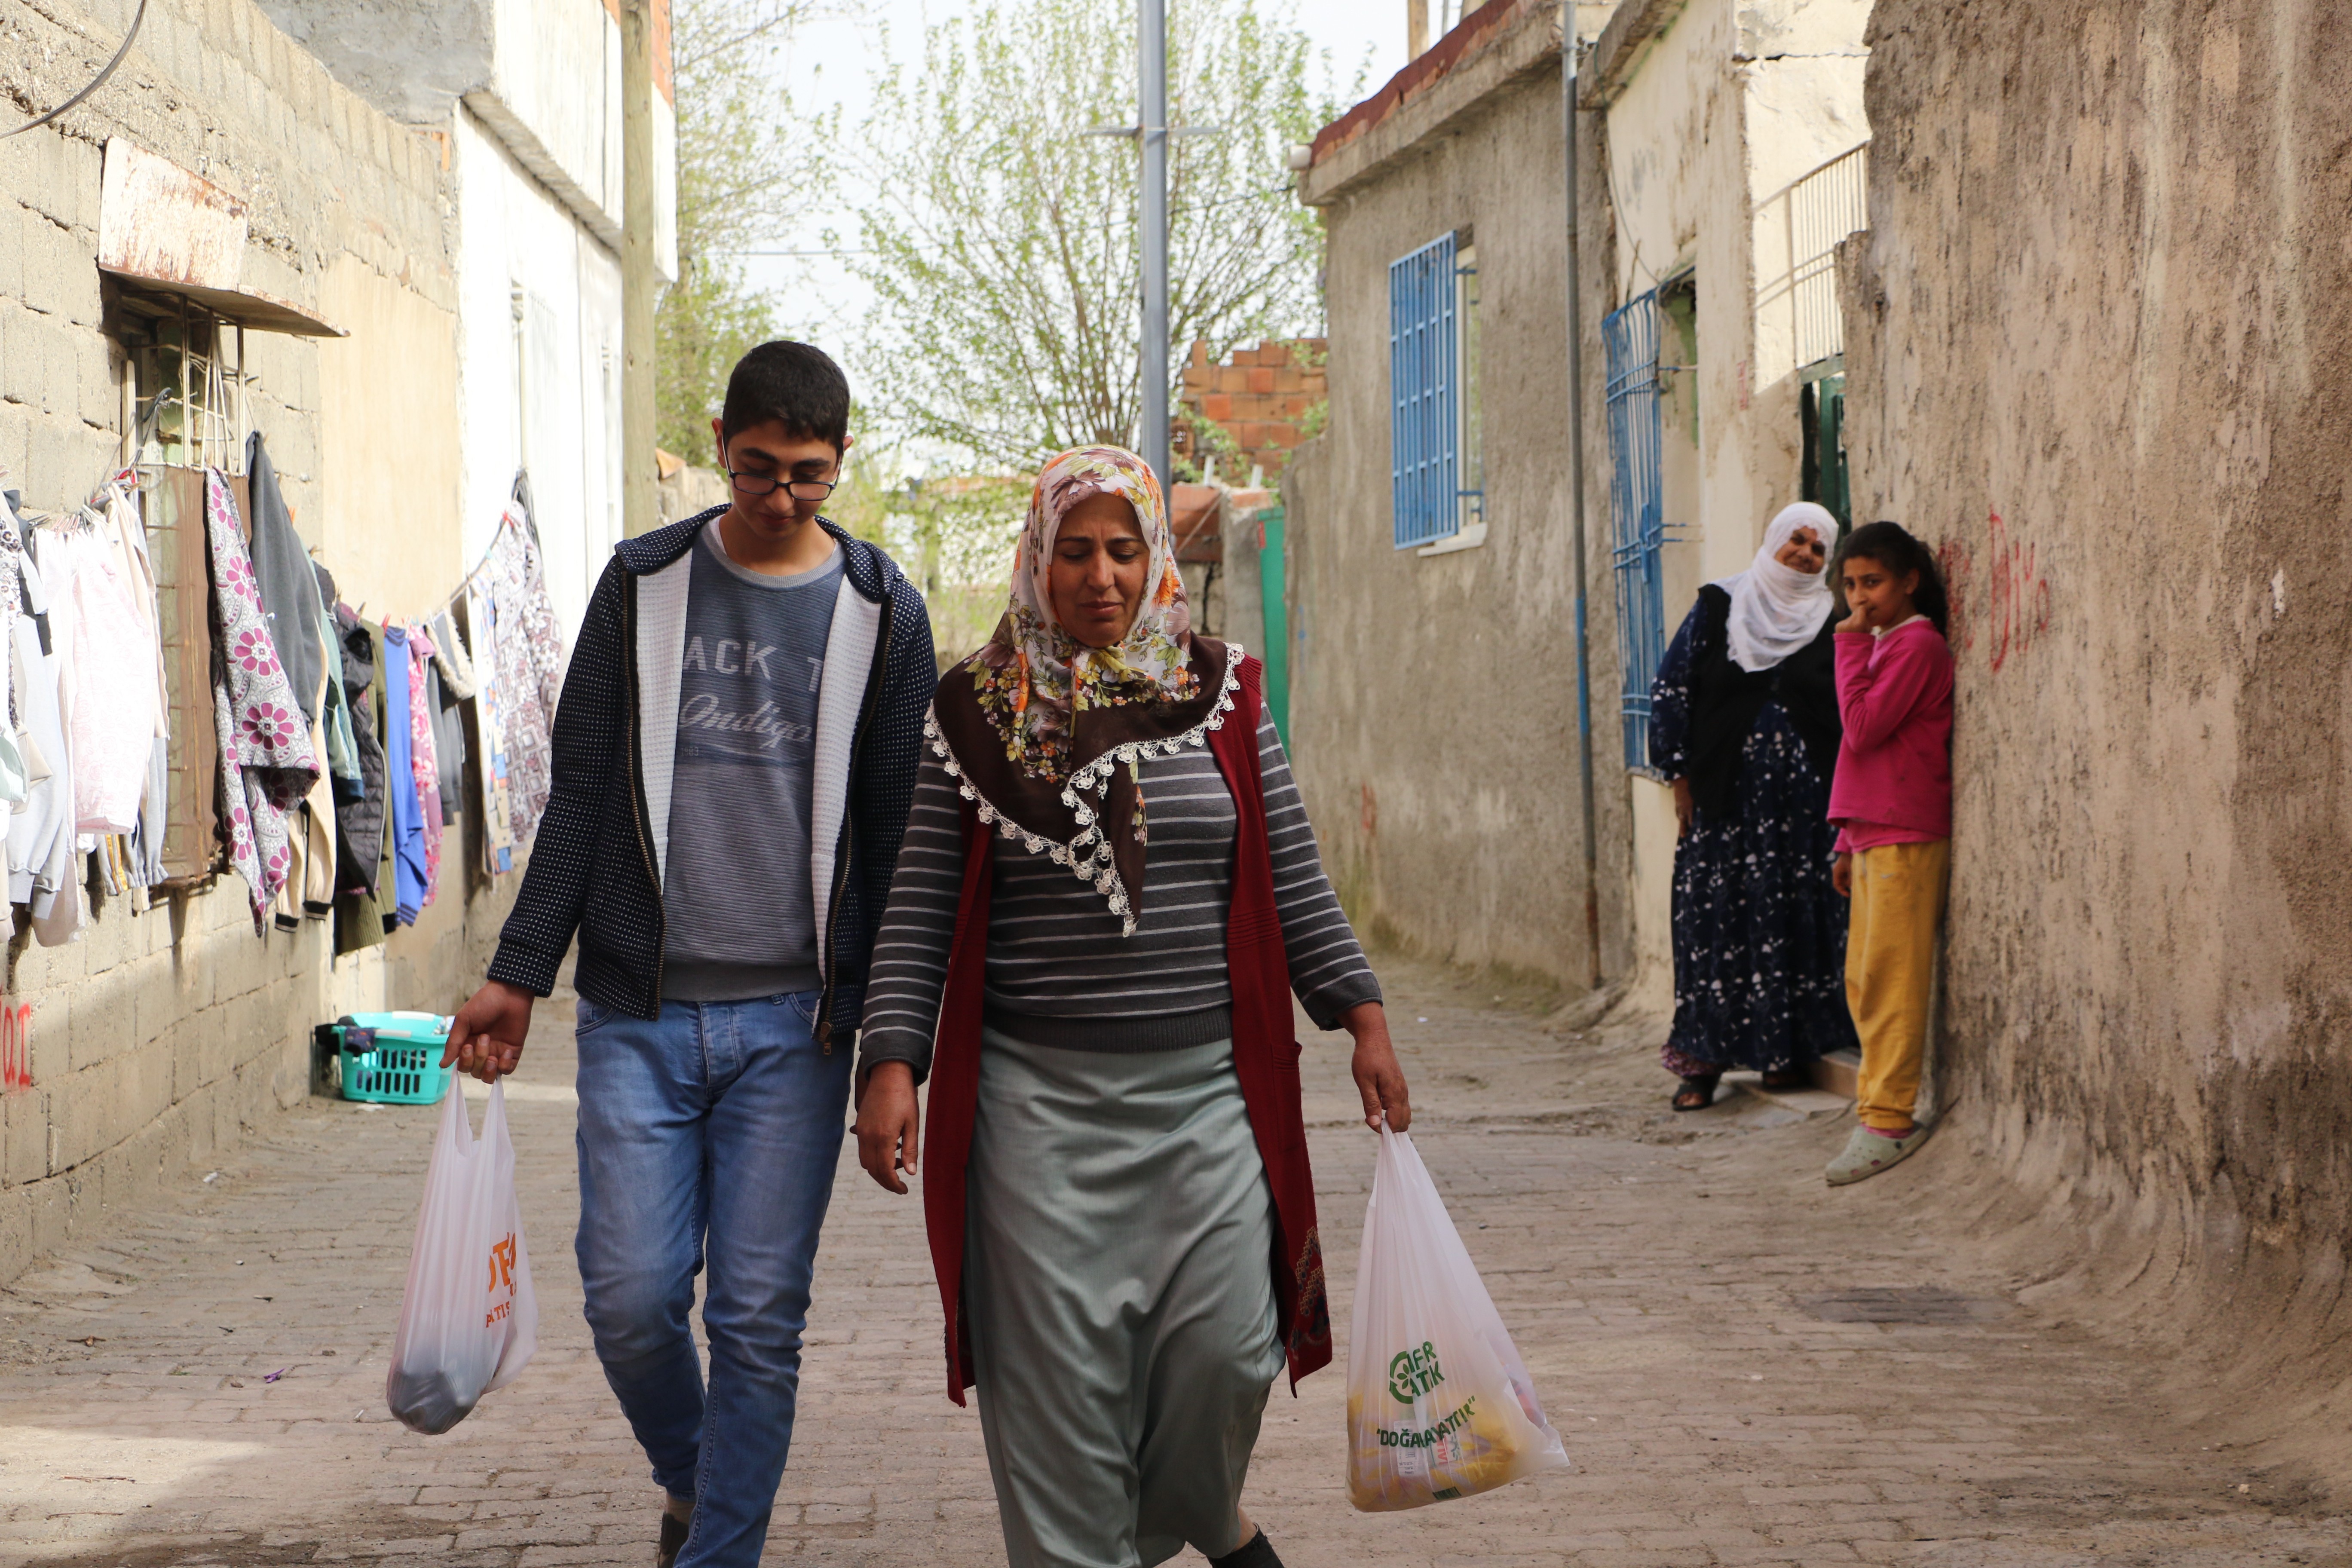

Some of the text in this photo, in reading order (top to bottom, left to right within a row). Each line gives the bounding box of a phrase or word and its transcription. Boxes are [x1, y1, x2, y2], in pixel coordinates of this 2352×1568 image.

[683, 636, 824, 692] ACK T
[1410, 1361, 1445, 1396] ATK
